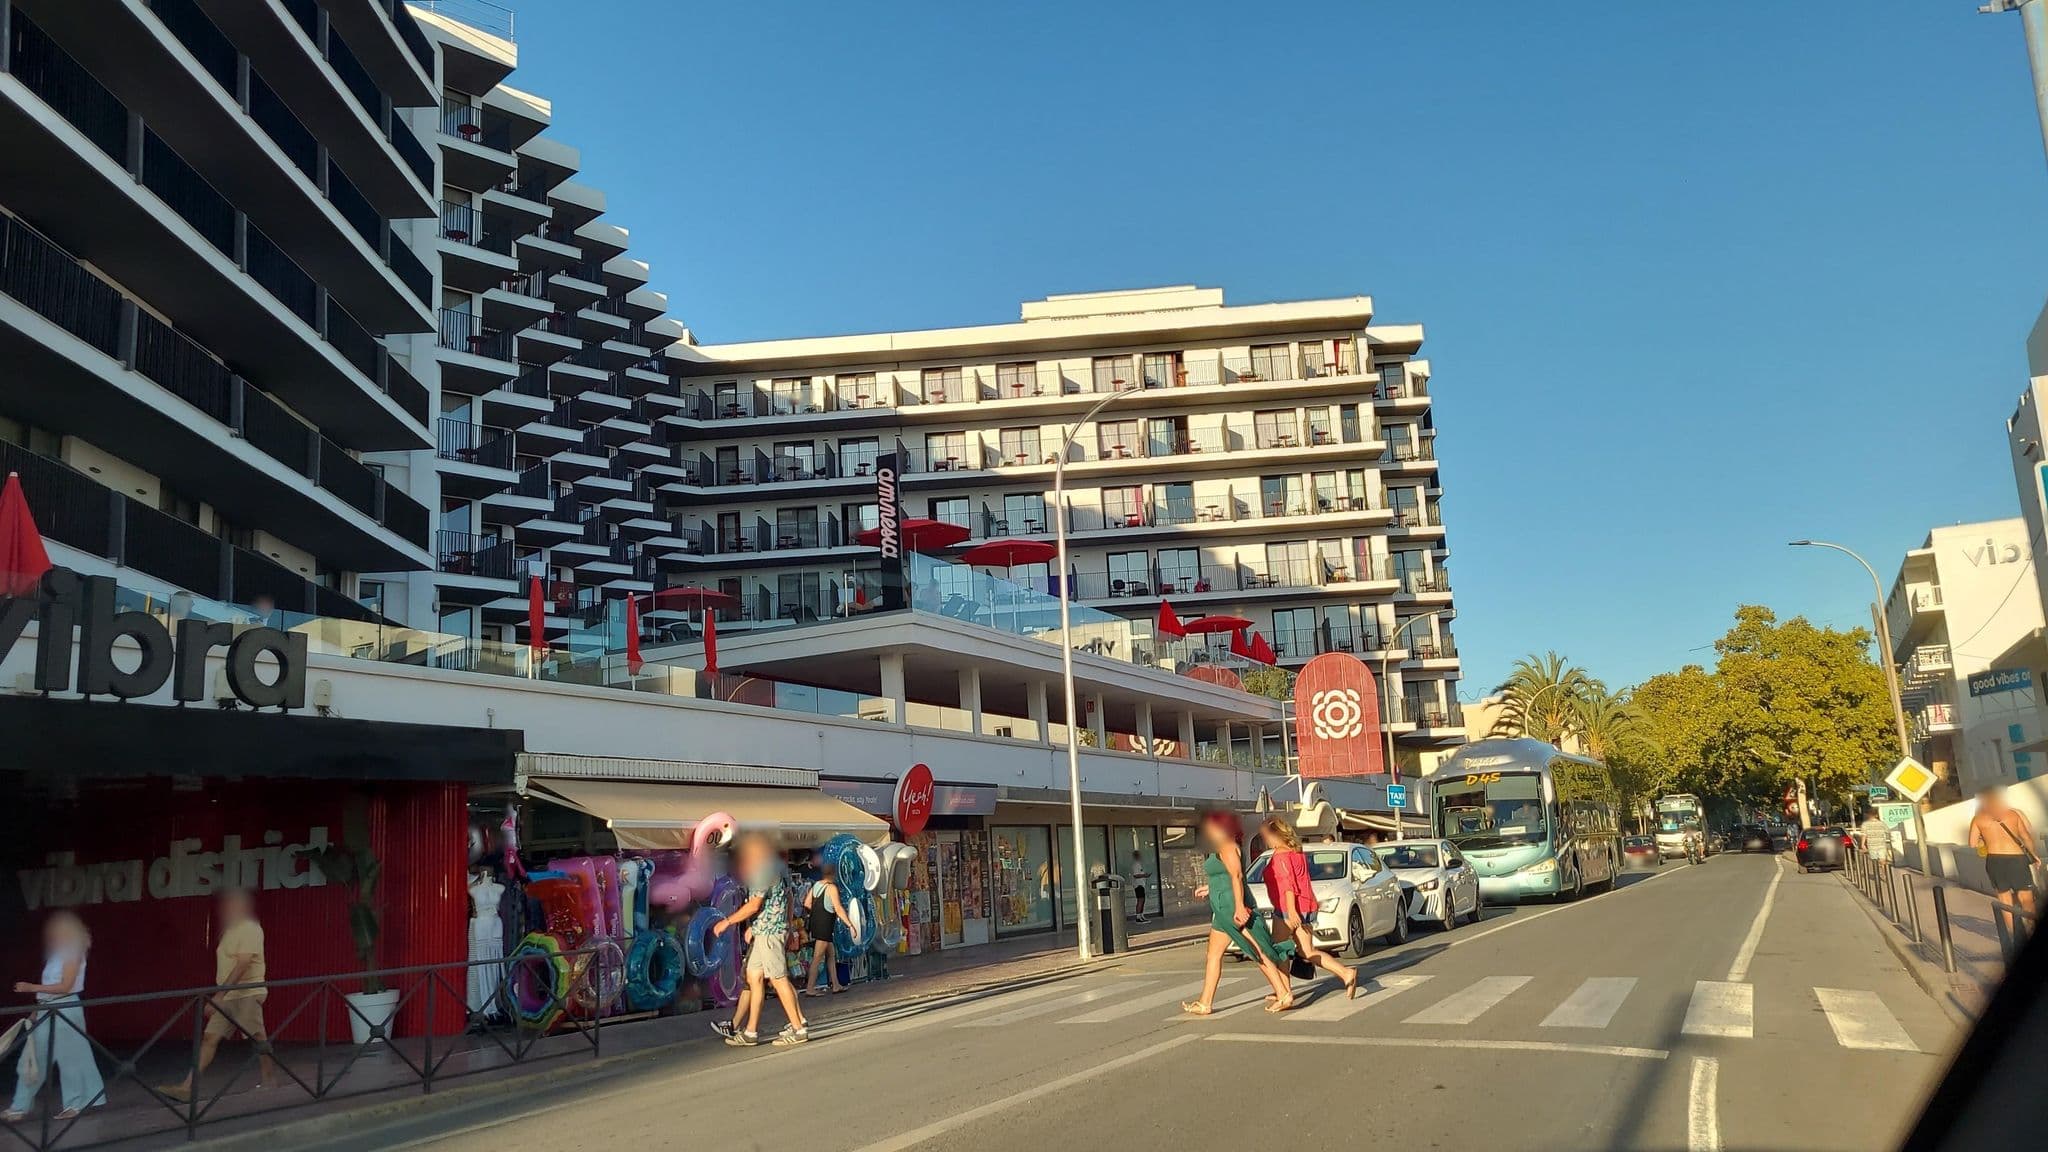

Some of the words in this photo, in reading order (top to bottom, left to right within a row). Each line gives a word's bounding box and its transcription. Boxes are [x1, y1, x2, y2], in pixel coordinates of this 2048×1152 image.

[878, 468, 898, 558] amnesia
[1962, 538, 2032, 567] vib
[1973, 675, 1996, 693] good
[1996, 671, 2020, 685] vibes
[1389, 791, 1405, 800] TAXI
[1889, 808, 1909, 816] ATM
[17, 851, 143, 910] vibra
[148, 826, 334, 899] district
